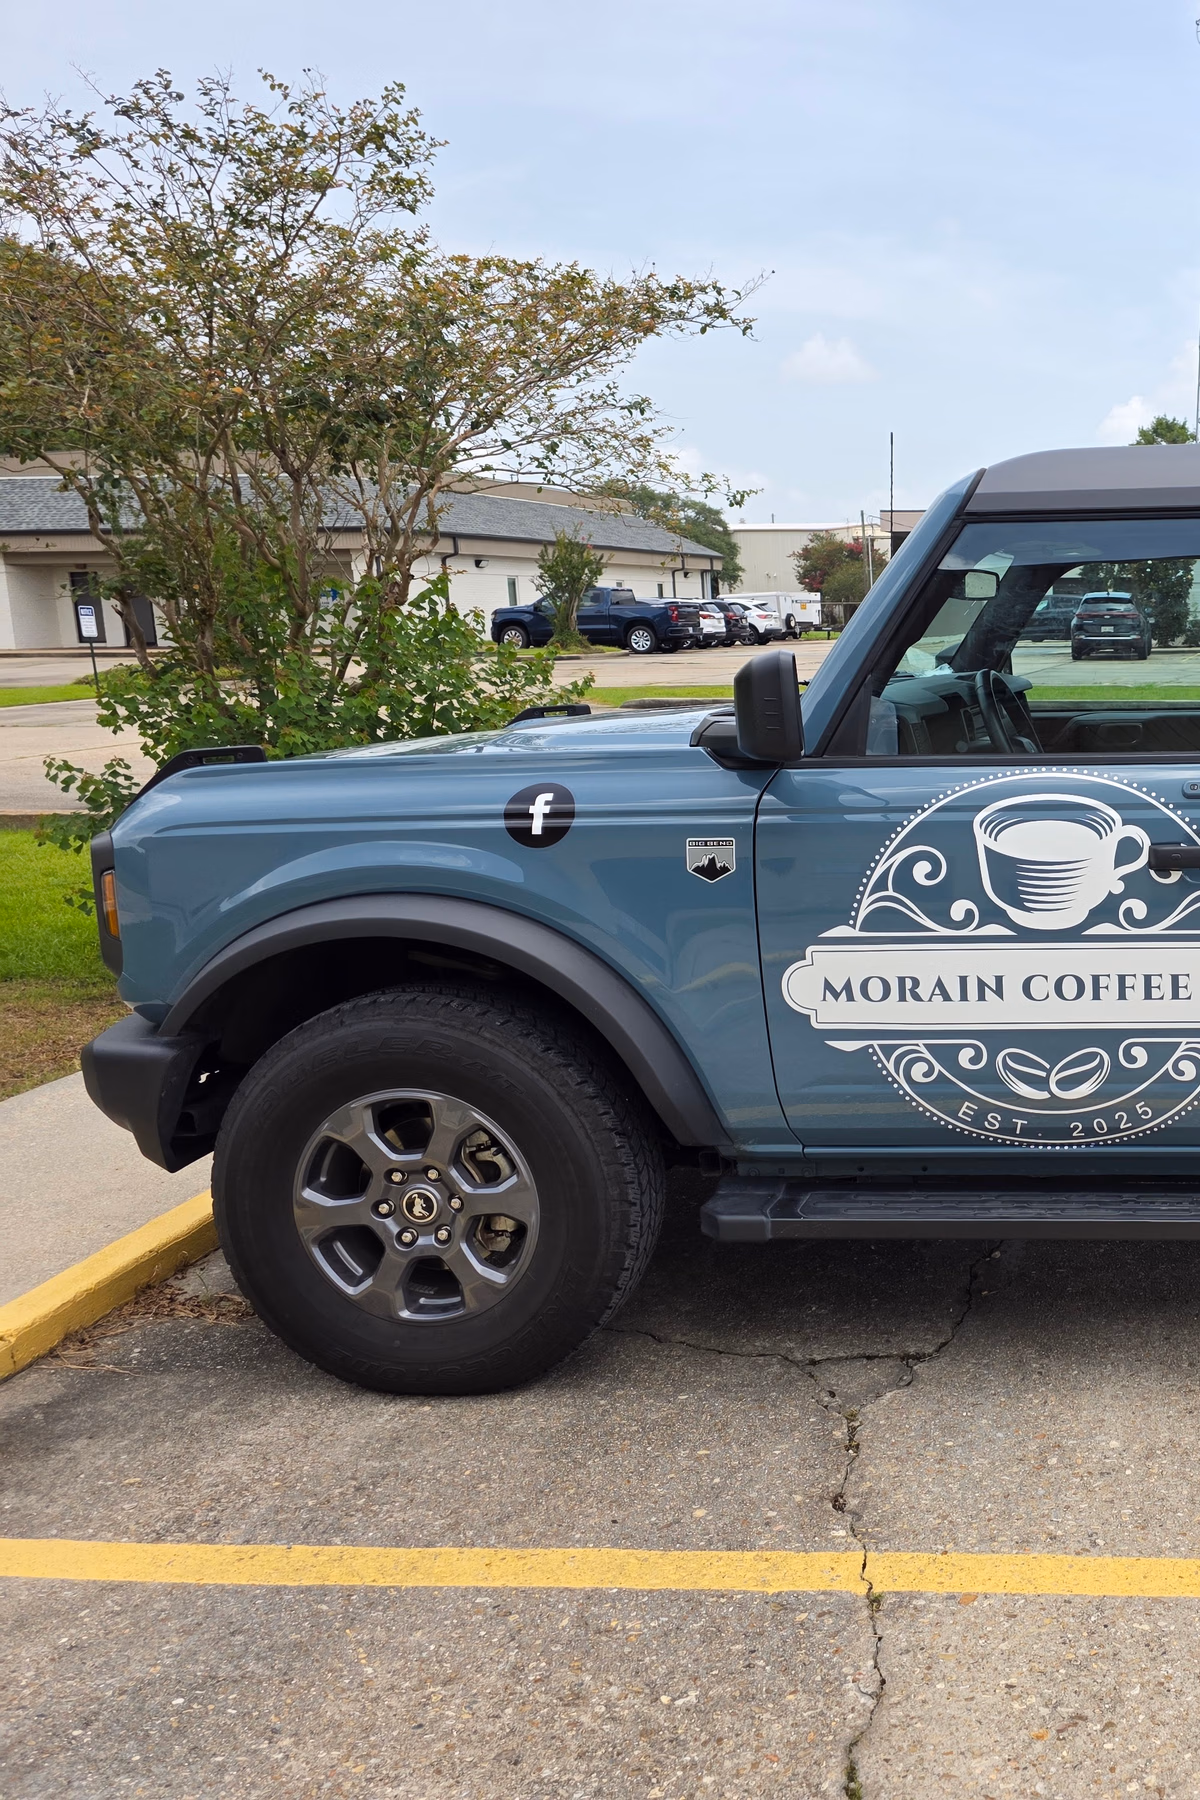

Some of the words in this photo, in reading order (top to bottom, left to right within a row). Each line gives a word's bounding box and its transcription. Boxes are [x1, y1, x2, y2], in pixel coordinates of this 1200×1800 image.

[821, 974, 1005, 1004] MORAIN
[1021, 973, 1192, 1002] COFFEE
[957, 1101, 1042, 1136] EST.
[1069, 1101, 1153, 1137] 2025
